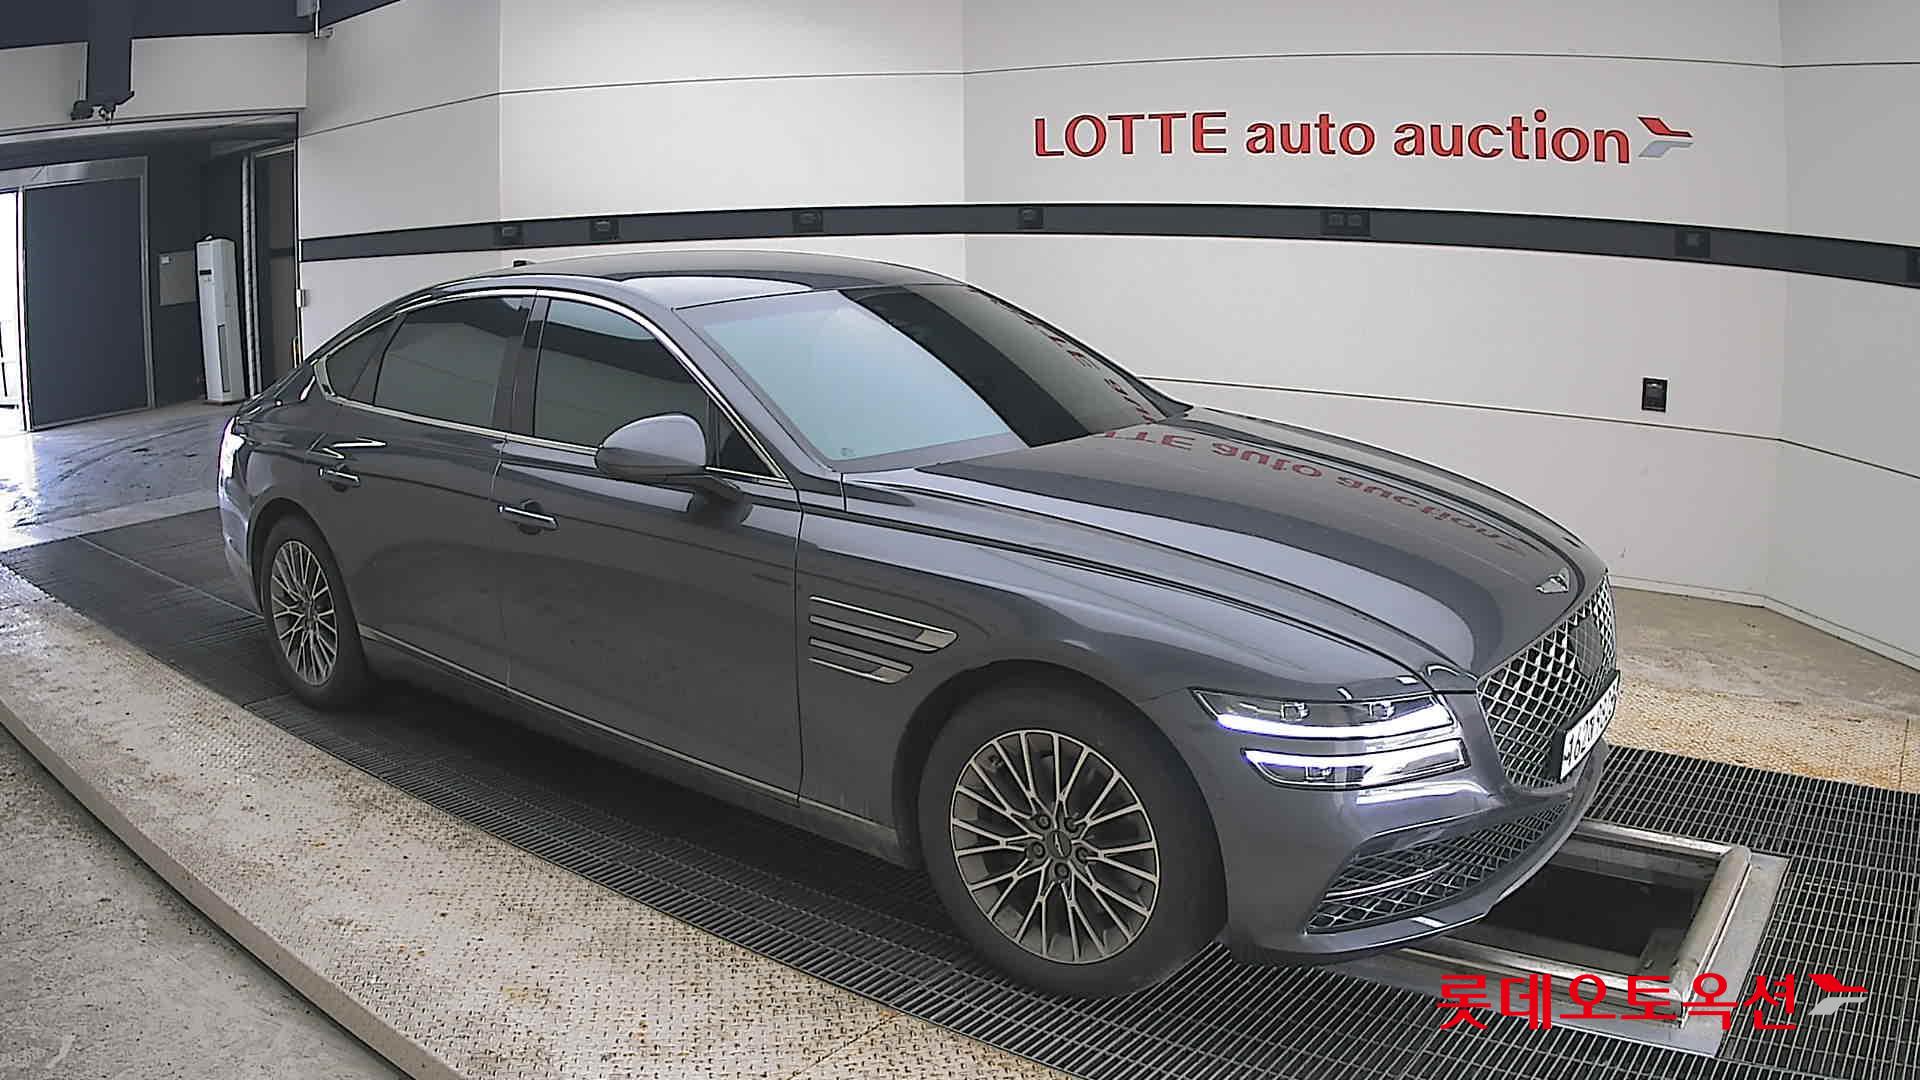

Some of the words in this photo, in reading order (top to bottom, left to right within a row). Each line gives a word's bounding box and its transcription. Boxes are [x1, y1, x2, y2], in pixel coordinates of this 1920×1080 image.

[1034, 111, 1228, 159] LOTTE
[1246, 112, 1376, 157] auto
[1393, 109, 1631, 164] auction
